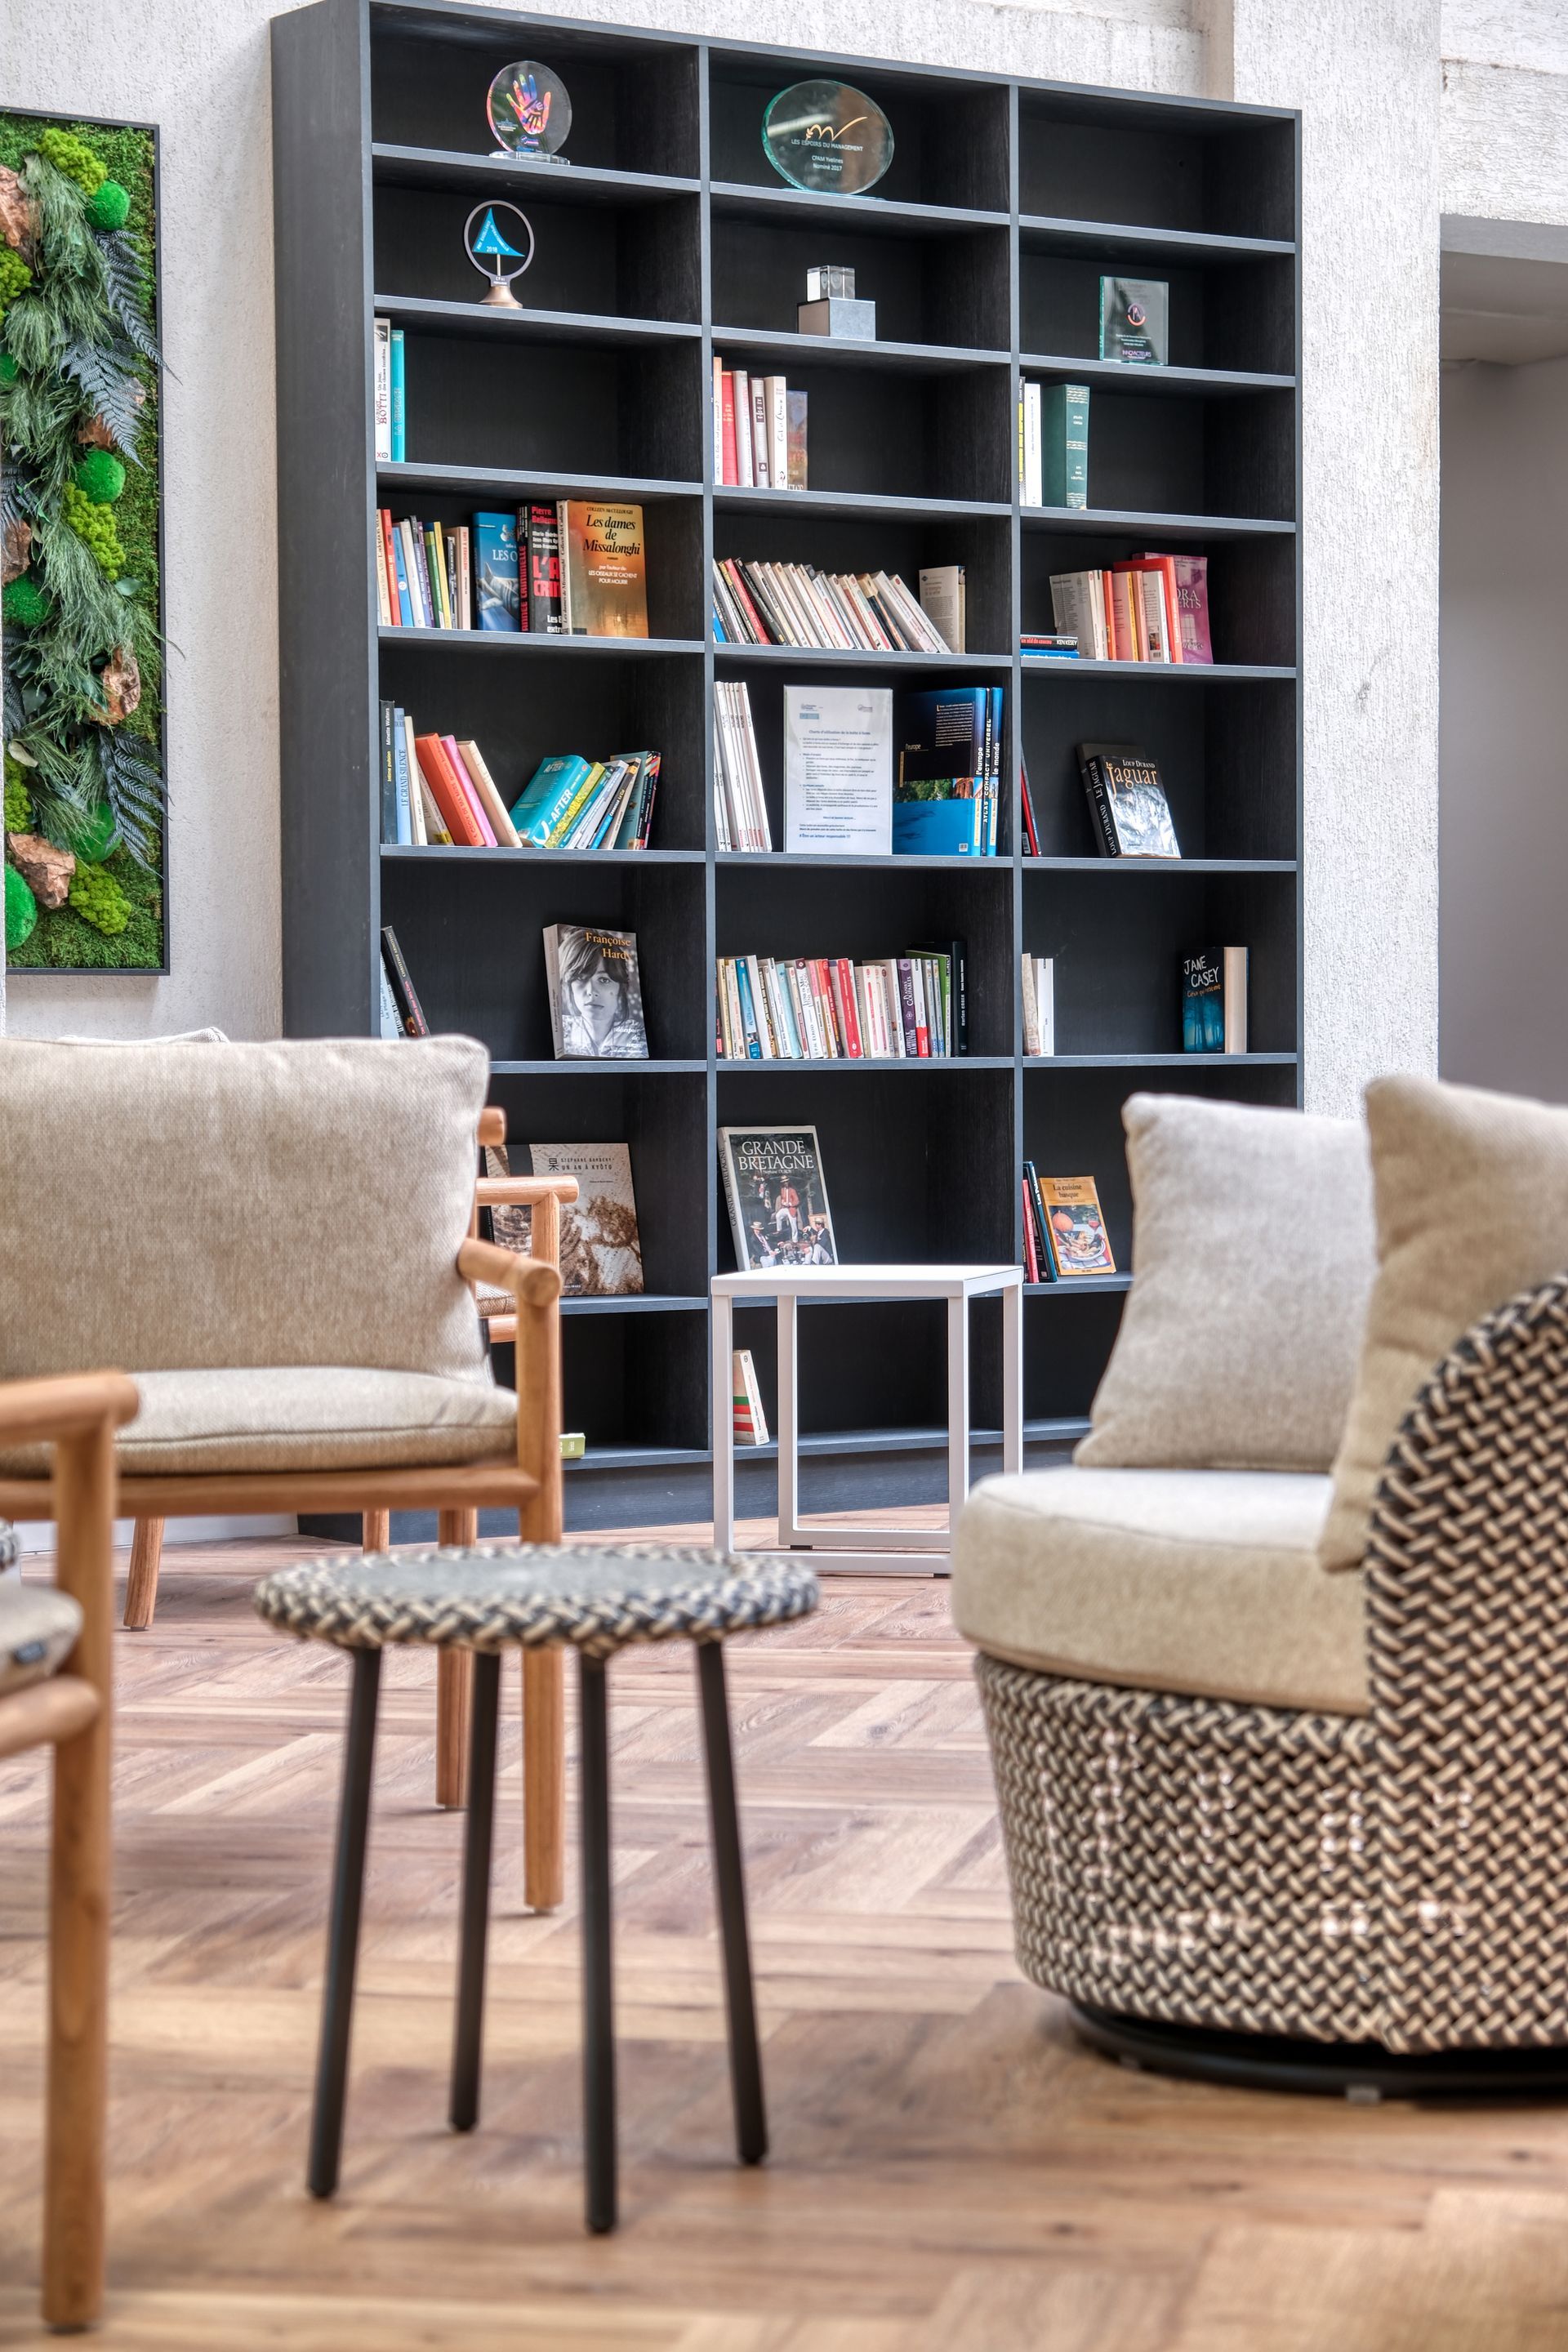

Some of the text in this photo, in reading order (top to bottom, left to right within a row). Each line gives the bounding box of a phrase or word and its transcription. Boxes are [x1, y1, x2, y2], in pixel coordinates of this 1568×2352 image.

[831, 143, 863, 151] MANAGEMENT
[532, 506, 551, 515] Pierre
[586, 515, 636, 530] Les dames
[605, 529, 617, 540] de
[493, 549, 508, 560] LES
[583, 539, 641, 557] Missalonghi
[992, 767, 999, 775] le
[1108, 766, 1158, 800] Jaguar
[546, 787, 575, 822] AFTER
[1089, 761, 1116, 856] LOUP DURAND LE JAGUAR
[585, 932, 631, 947] Françoise
[603, 948, 632, 961] Hardy
[1184, 956, 1207, 974] JANE
[1191, 967, 1219, 988] CASEY
[904, 976, 913, 1006] COUPABLES
[908, 1028, 917, 1054] HAMILTON
[742, 1140, 806, 1155] GRANDE
[738, 1155, 814, 1170] BRETAGNE
[719, 1148, 736, 1226] GRANDE BRETAGNE
